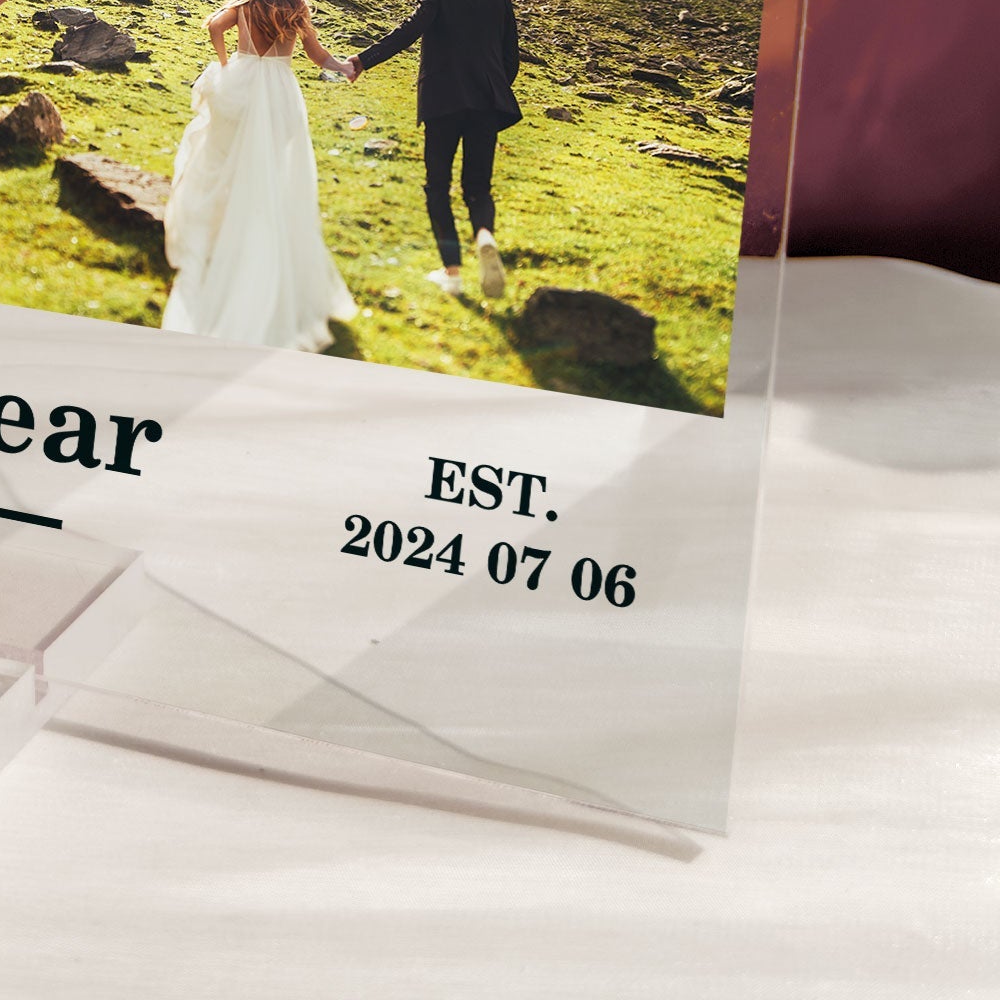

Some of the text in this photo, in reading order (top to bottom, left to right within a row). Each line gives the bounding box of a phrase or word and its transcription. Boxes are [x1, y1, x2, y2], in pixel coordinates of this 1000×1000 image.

[424, 456, 558, 522] EST.
[340, 514, 637, 608] 2024 07 06
